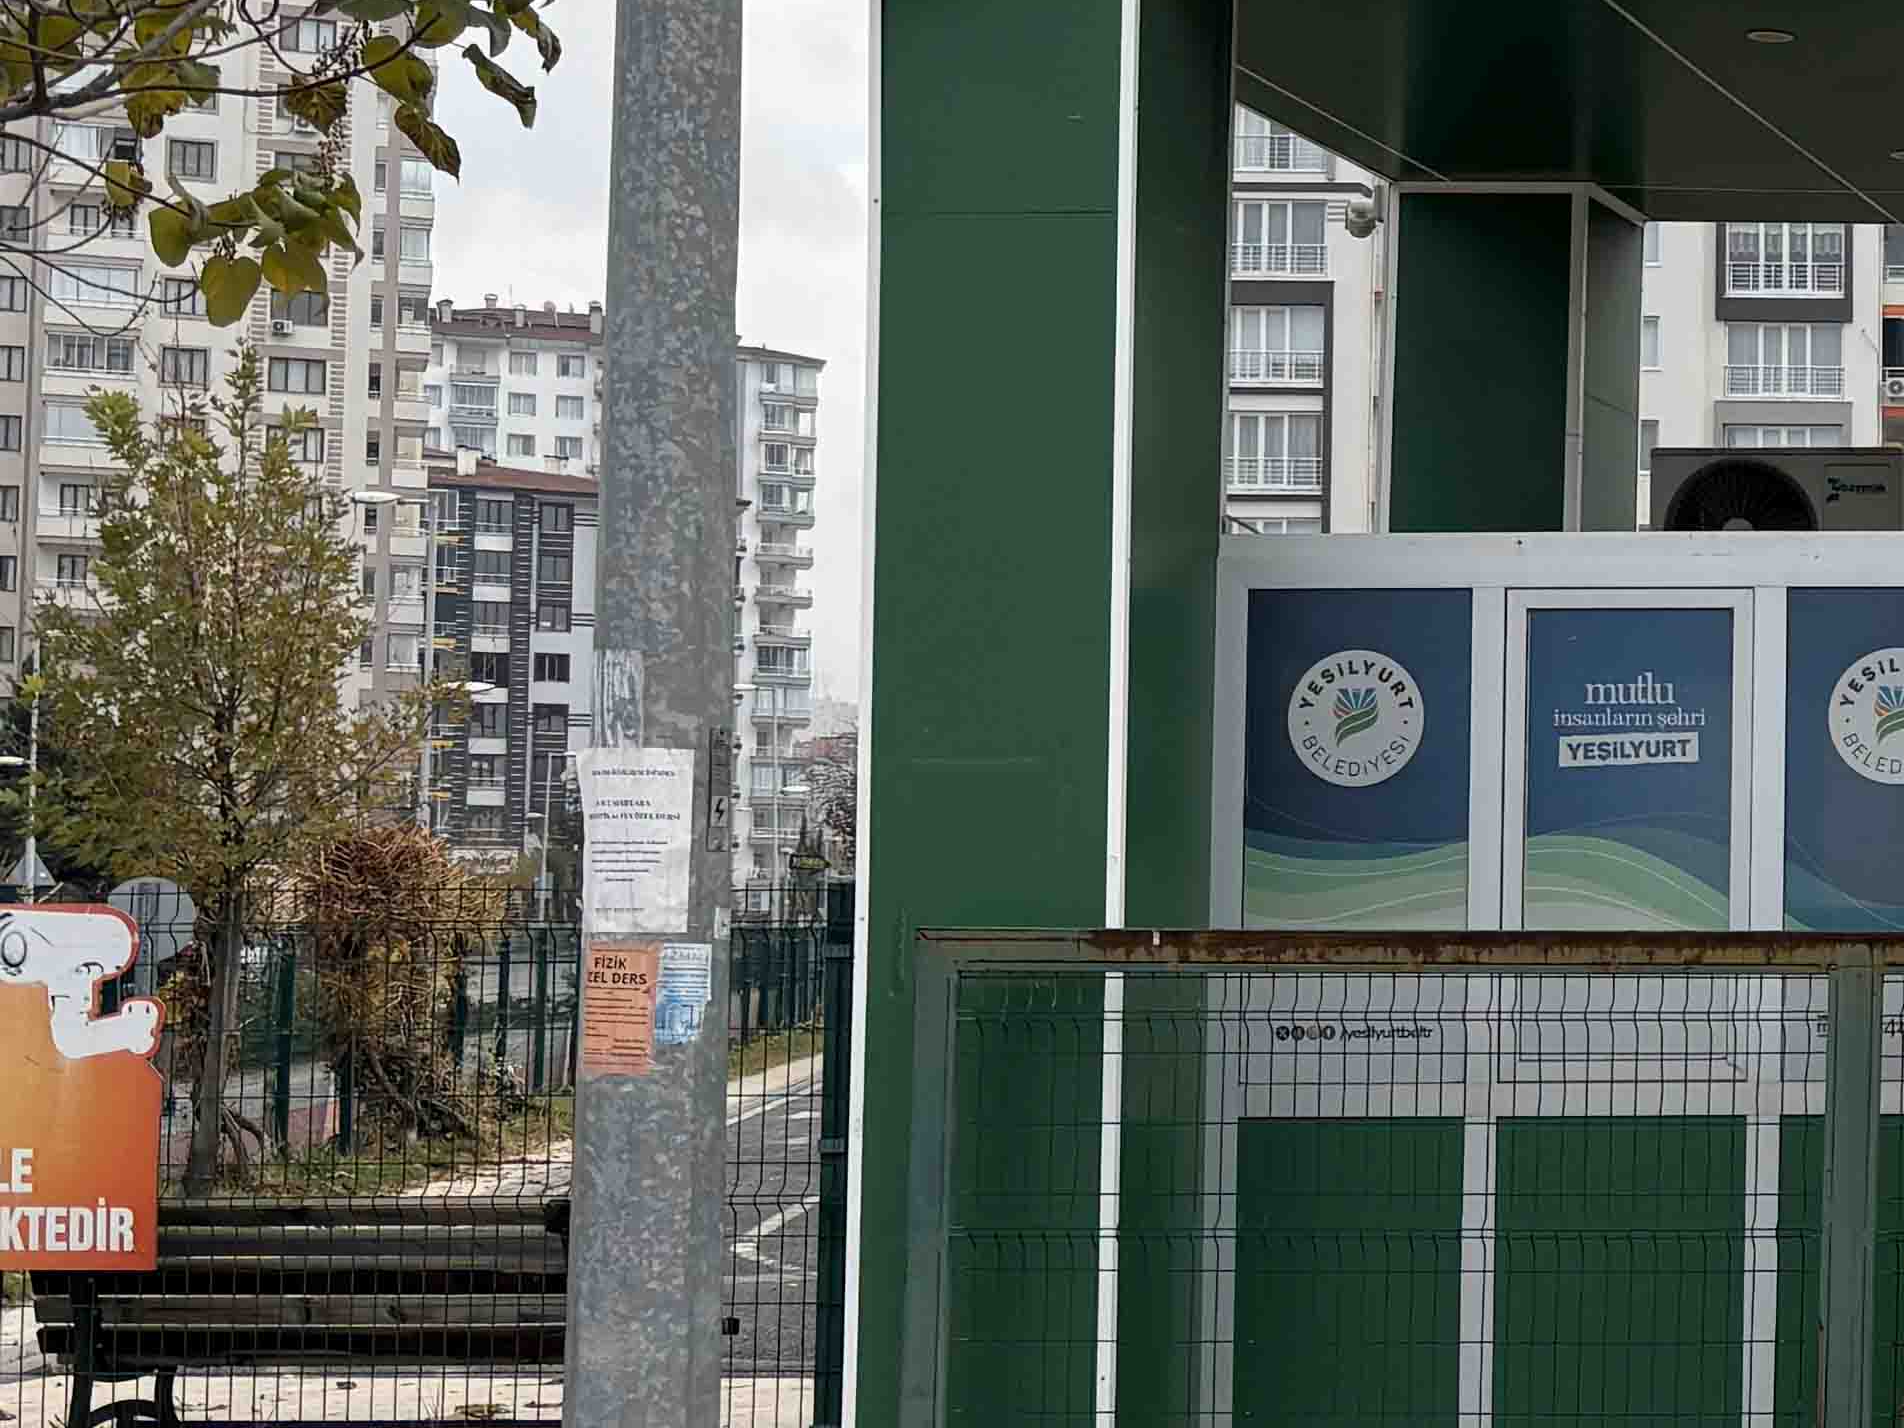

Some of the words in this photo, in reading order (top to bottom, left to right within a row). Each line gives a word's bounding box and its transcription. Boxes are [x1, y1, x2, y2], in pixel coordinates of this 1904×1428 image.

[1583, 671, 1677, 705] mutlu
[594, 955, 627, 970] FİZİK
[612, 972, 647, 985] DERS
